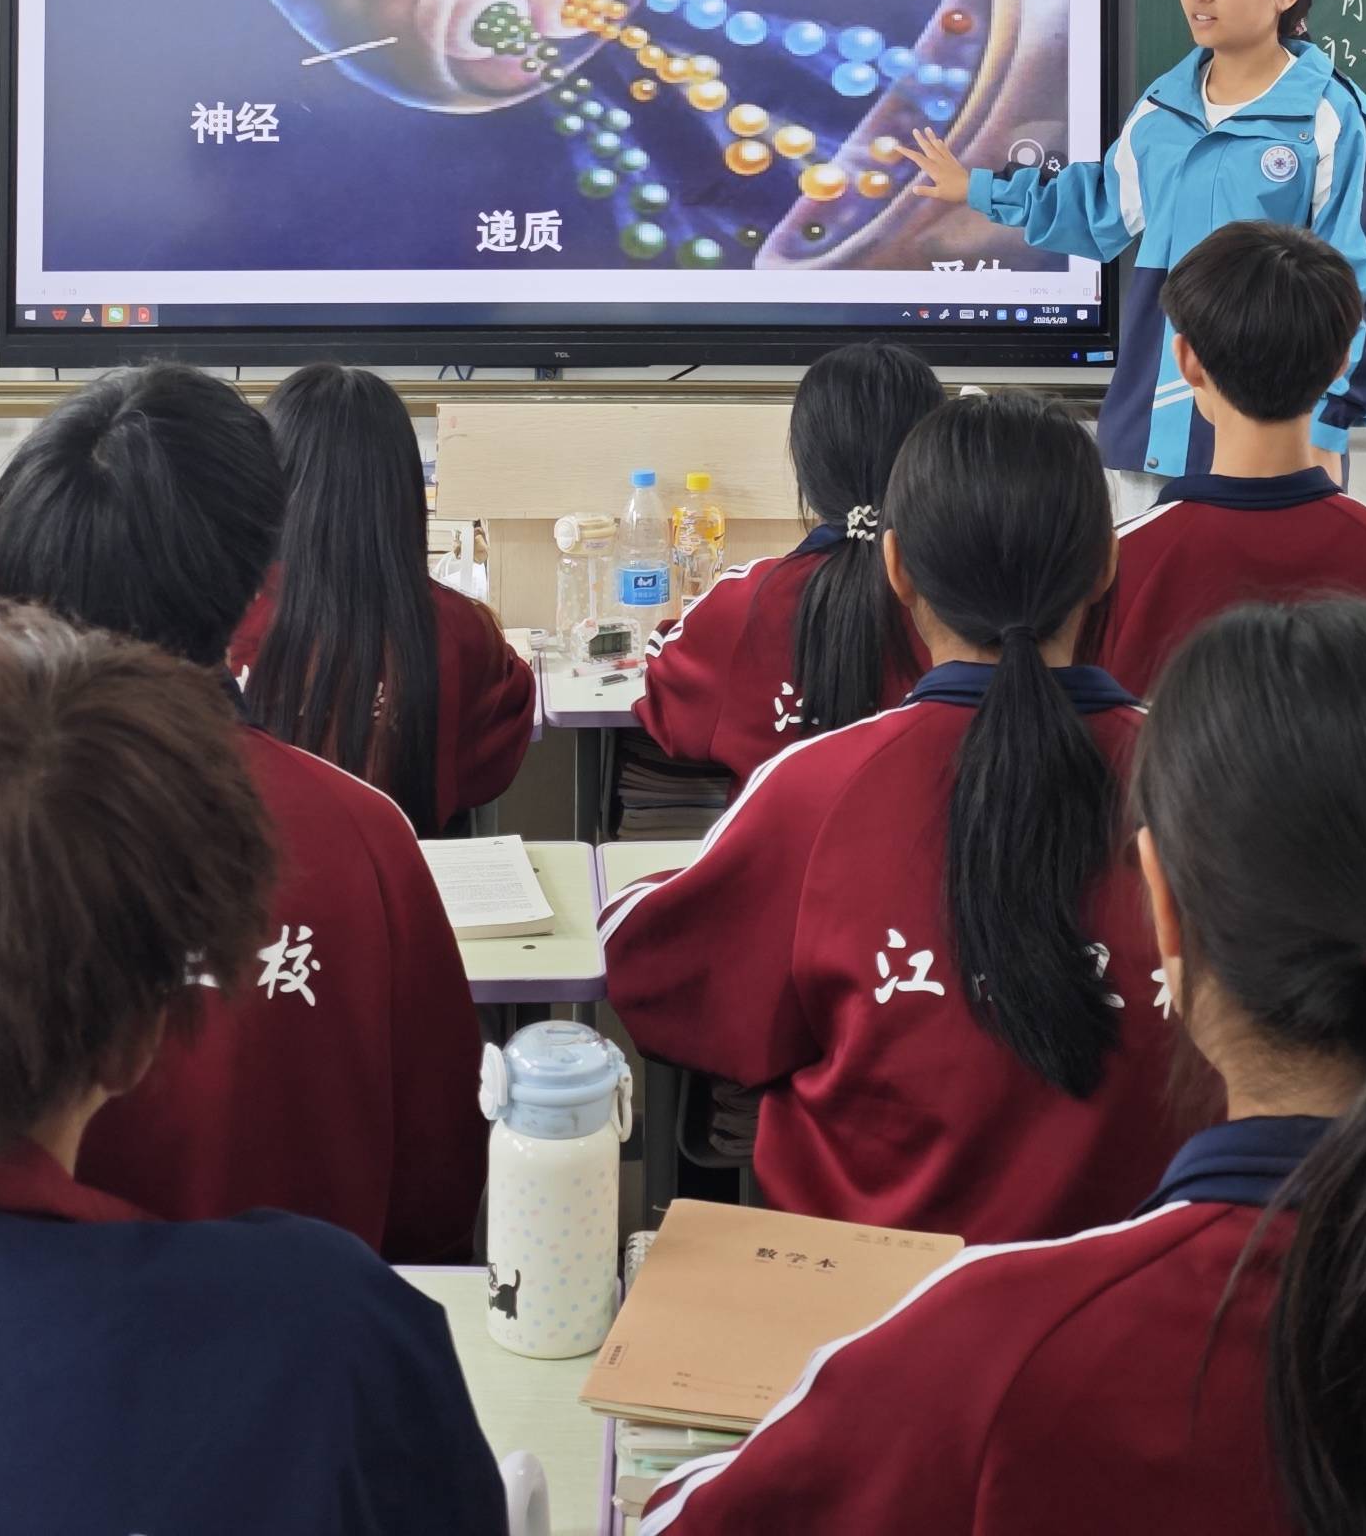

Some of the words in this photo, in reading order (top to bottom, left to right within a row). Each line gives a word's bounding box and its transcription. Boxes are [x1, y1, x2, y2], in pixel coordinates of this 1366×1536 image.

[191, 102, 280, 144] 神经
[476, 209, 563, 254] 递质
[756, 1247, 838, 1269] 数学本
